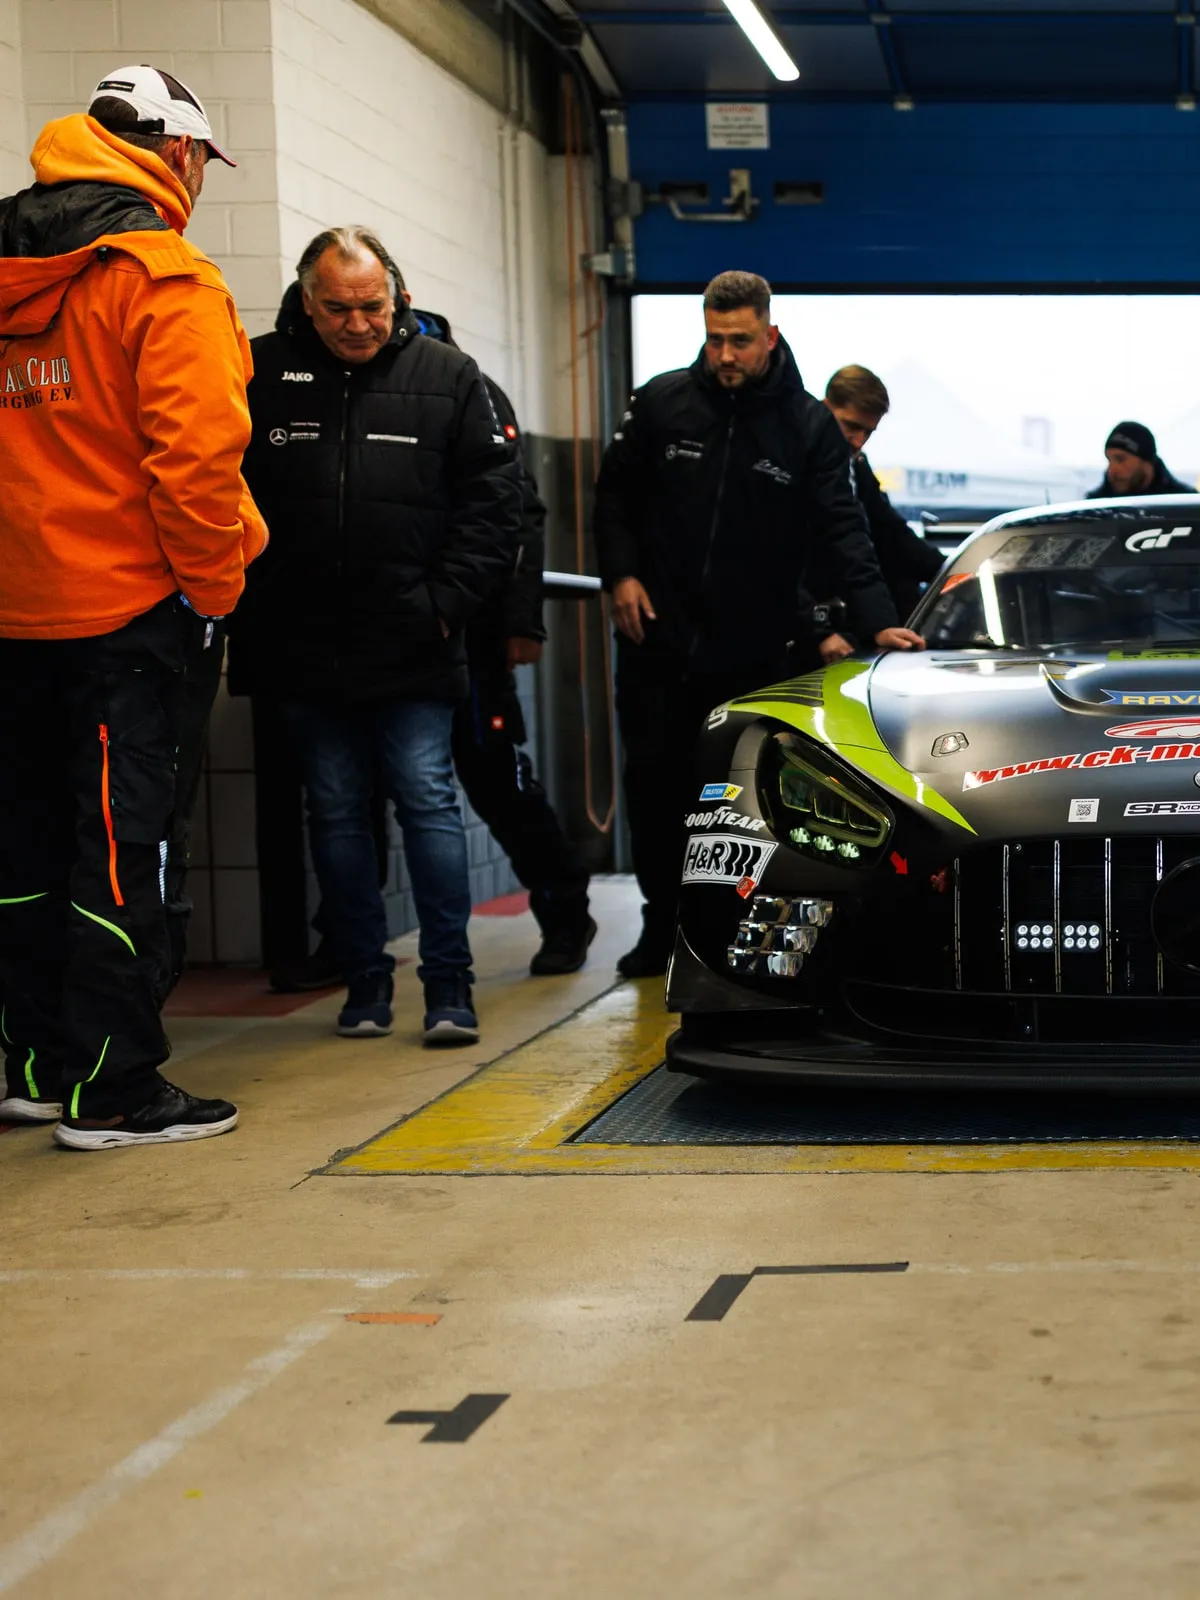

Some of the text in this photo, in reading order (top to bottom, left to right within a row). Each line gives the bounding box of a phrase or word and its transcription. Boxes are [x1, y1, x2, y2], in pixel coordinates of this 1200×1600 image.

[27, 357, 70, 386] CLUB
[281, 371, 314, 382] JAKO
[50, 387, 75, 402] E.V.
[1127, 803, 1178, 815] SR
[684, 840, 727, 876] H&R
